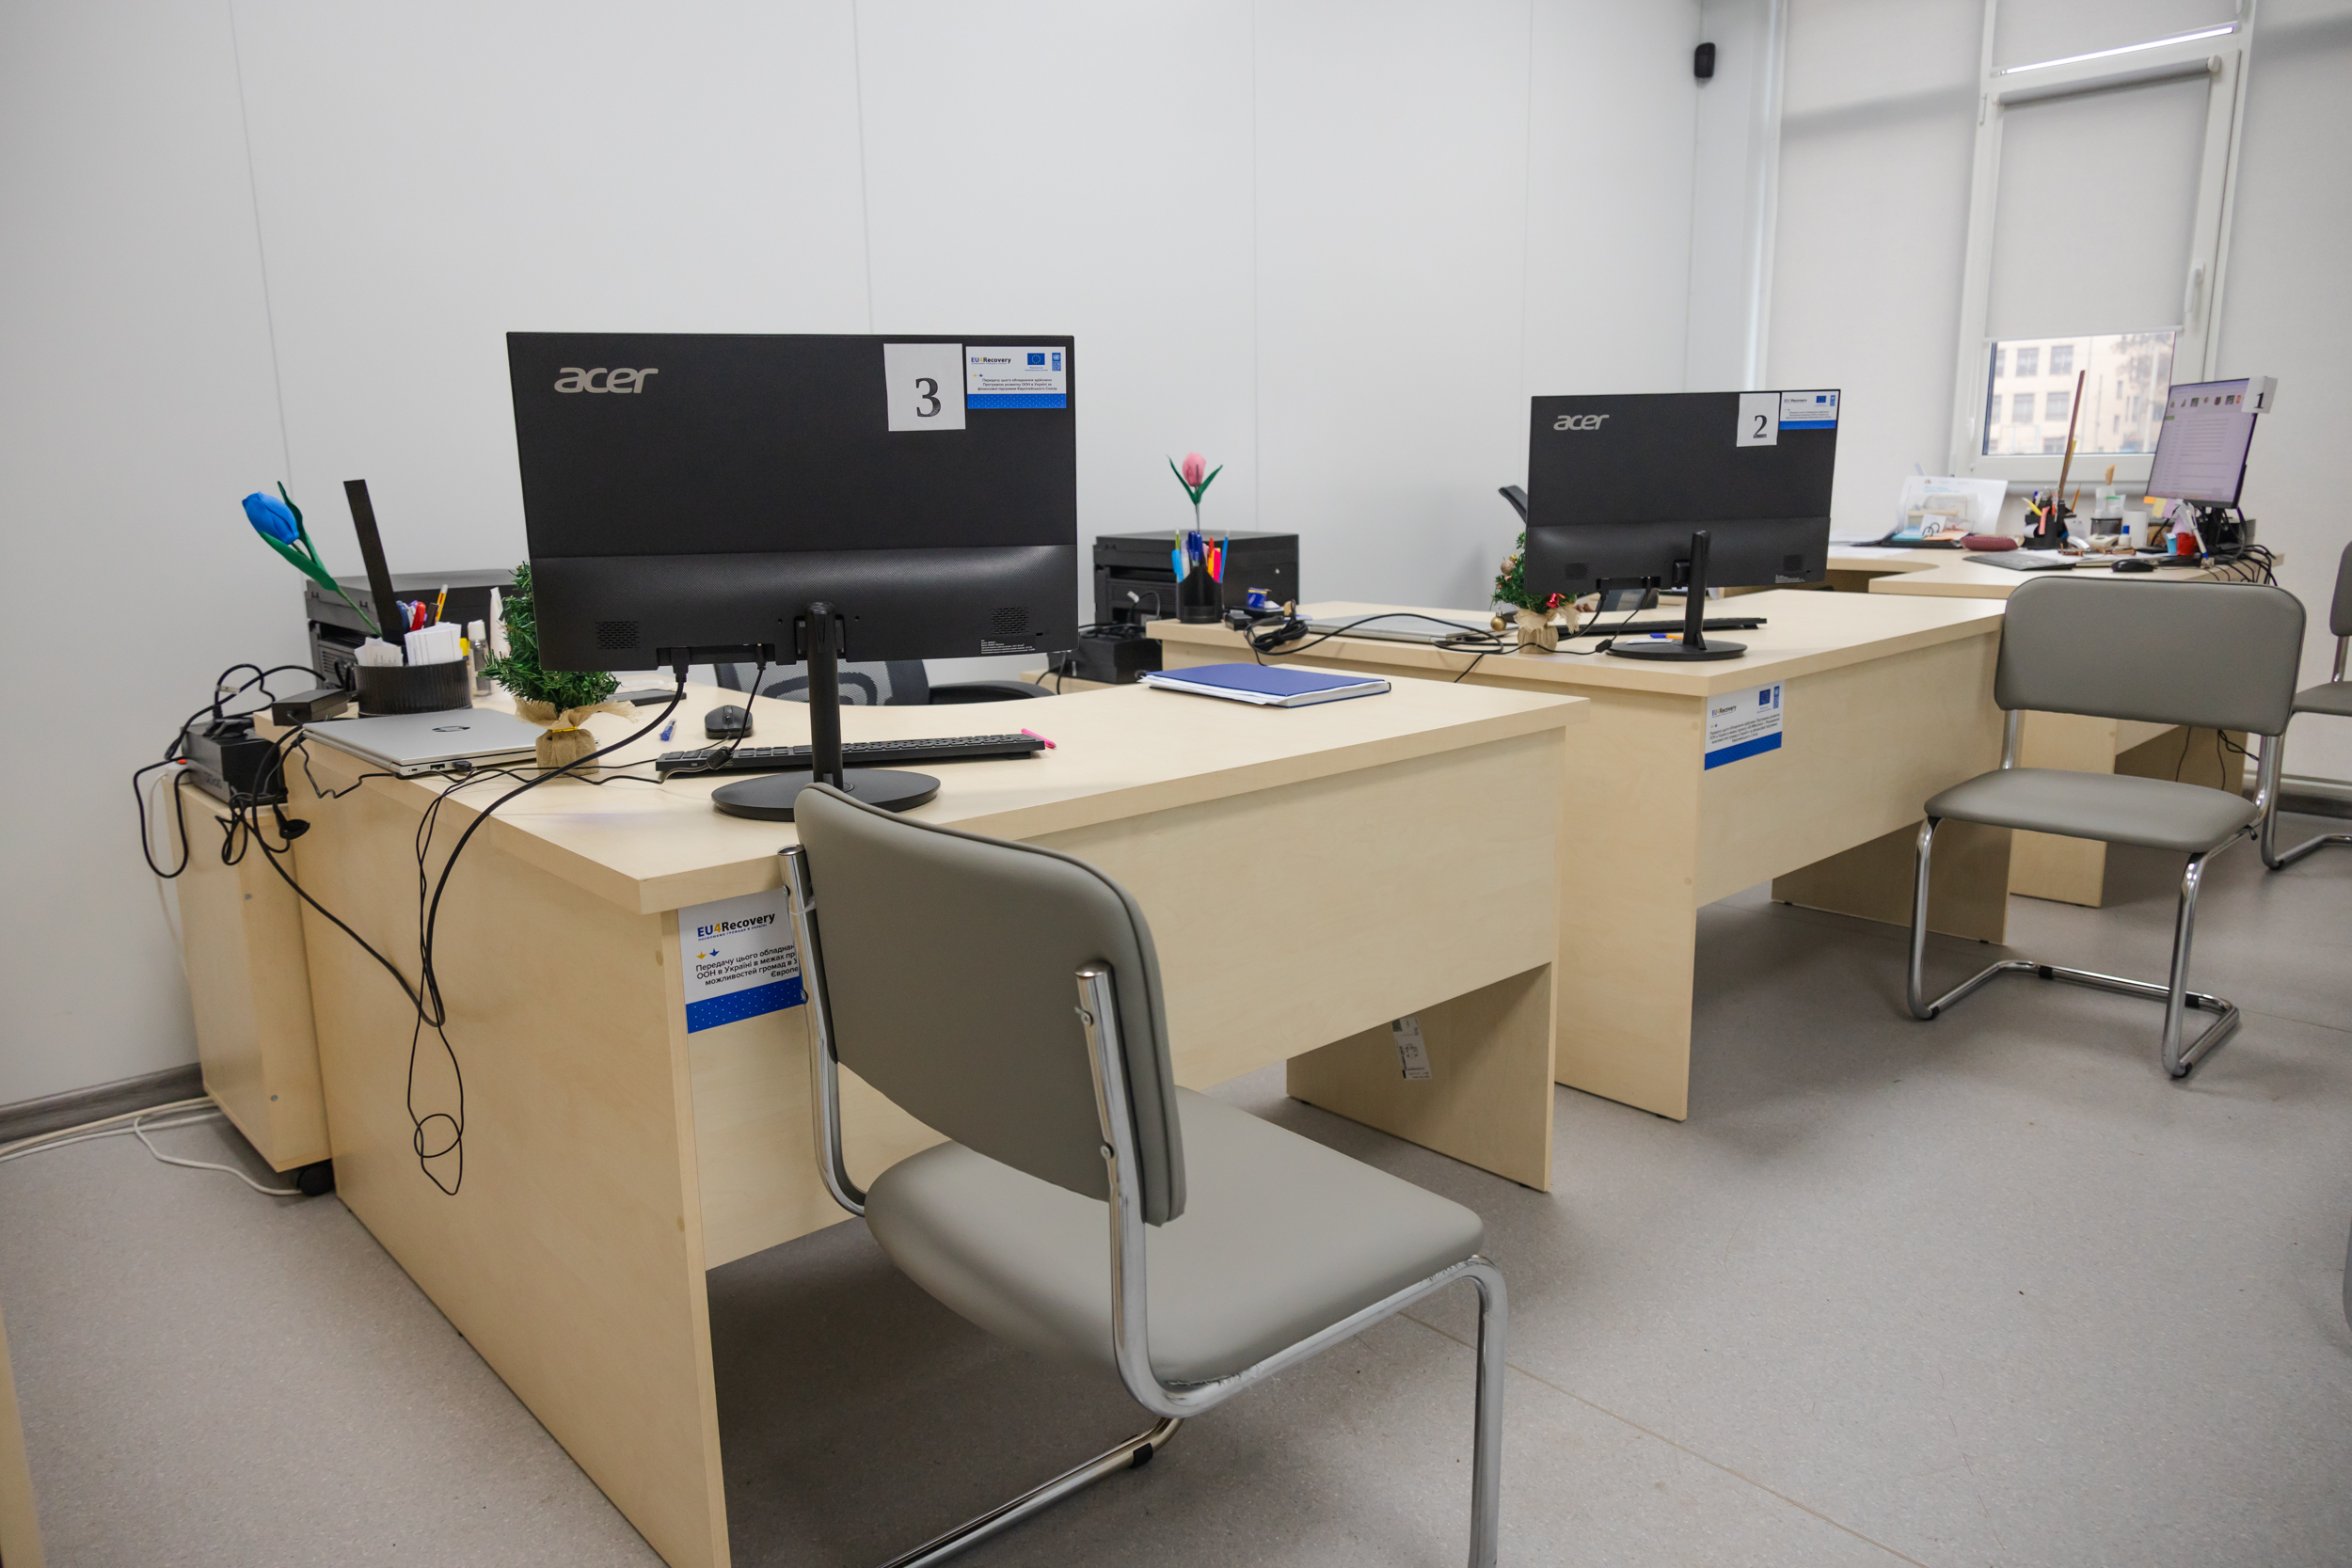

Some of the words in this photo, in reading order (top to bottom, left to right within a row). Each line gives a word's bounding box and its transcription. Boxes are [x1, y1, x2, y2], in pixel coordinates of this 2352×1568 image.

[554, 368, 659, 393] acer
[915, 377, 941, 417] 3
[2254, 392, 2264, 409] 1
[1553, 415, 1610, 431] acer
[1753, 415, 1767, 438] 2
[697, 913, 775, 938] EU4Recovery
[696, 958, 735, 972] Передачу
[736, 953, 758, 963] цього
[696, 970, 716, 979] ООН
[724, 960, 753, 974] Україні
[760, 956, 785, 964] межах
[705, 968, 757, 986] можливостей
[758, 962, 787, 974] громад
[771, 966, 799, 977] Європе
